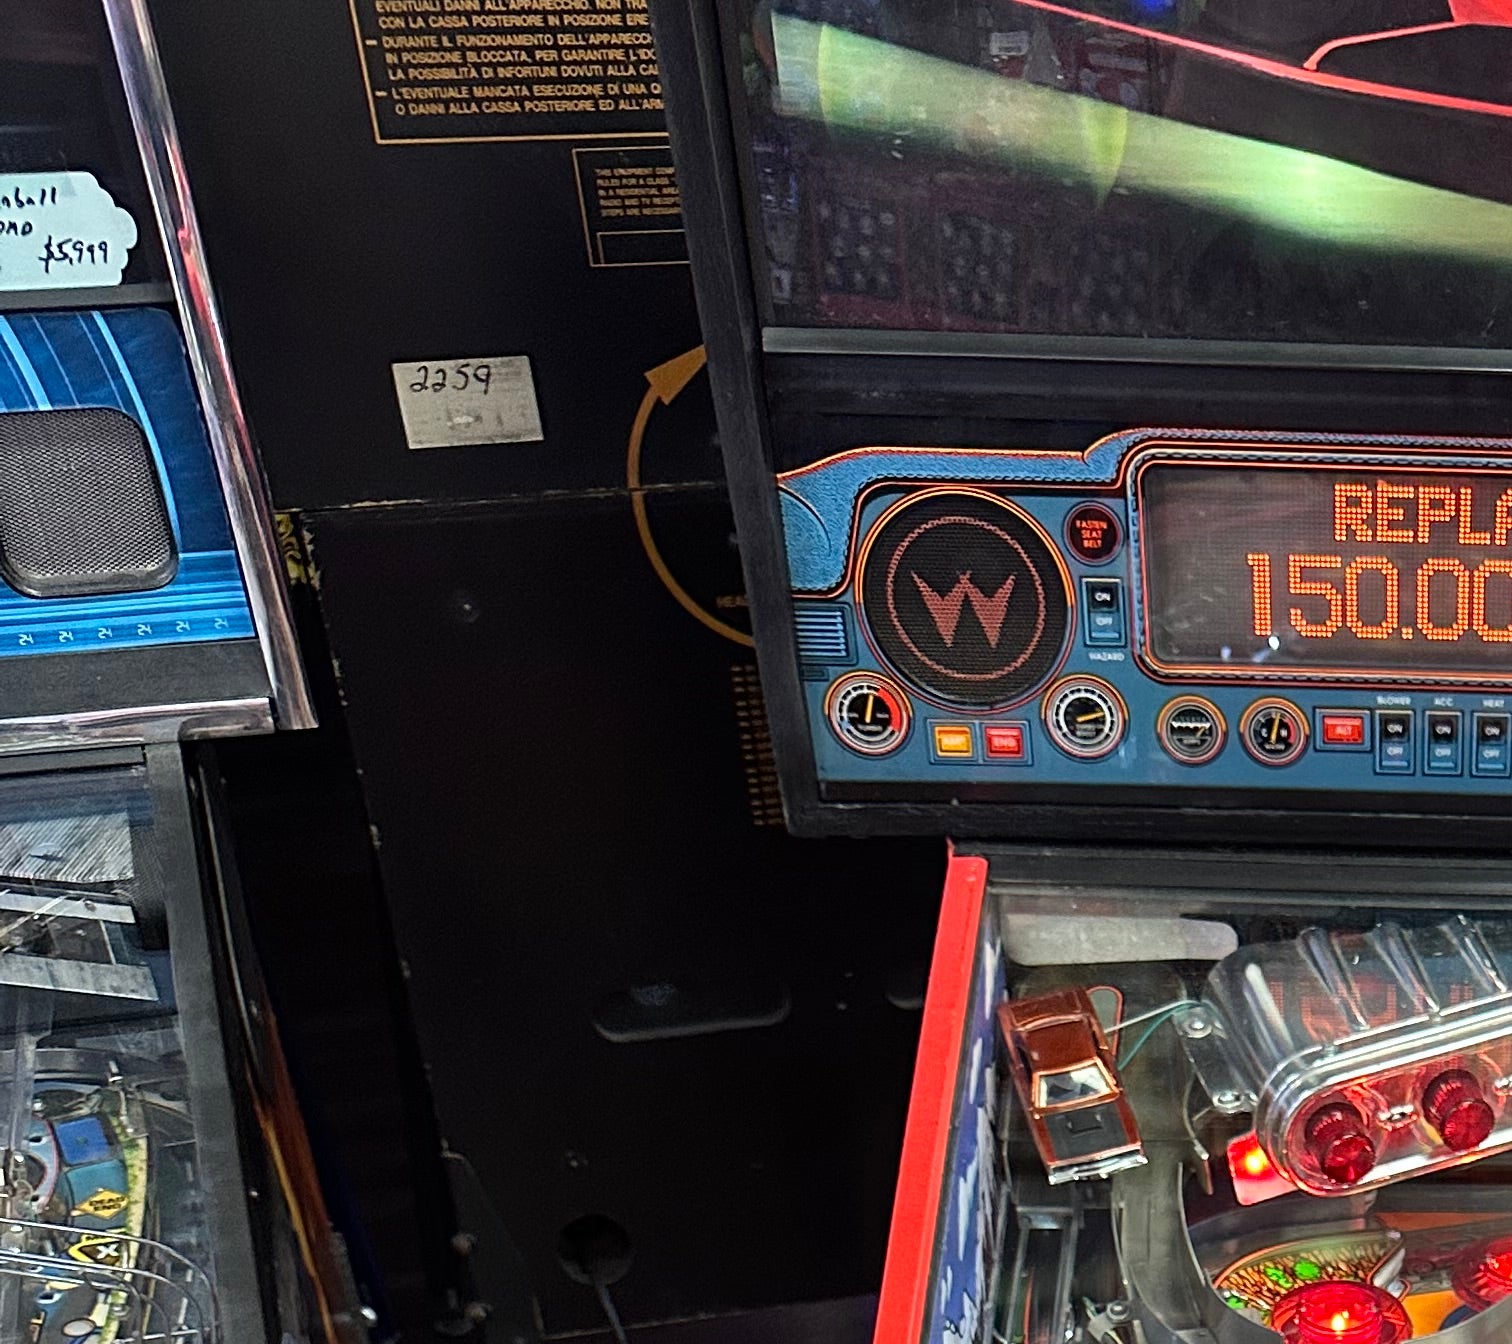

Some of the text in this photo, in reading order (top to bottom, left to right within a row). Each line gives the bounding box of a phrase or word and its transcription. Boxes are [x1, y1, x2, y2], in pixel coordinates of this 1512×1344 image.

[379, 16, 405, 28] CON
[408, 16, 426, 28] LA
[429, 16, 469, 27] CASSA
[472, 14, 545, 27] POSTERIORE
[547, 15, 560, 26] IN
[563, 14, 623, 26] POSIZIONE
[382, 34, 554, 48] DURANTE FUNZIONAMENTO
[401, 49, 626, 63] POSIZIONE GARANTIRE
[497, 64, 636, 78] INFORTUNI DOVUTI ALLA
[391, 84, 604, 99] L'EVENTUALE MANCATA ESECUZIONE
[408, 100, 596, 114] DANNI ALLA CASSA POSTERIORE
[38, 235, 108, 274] $5,999
[409, 363, 493, 395] 2259
[1094, 592, 1111, 602] ON
